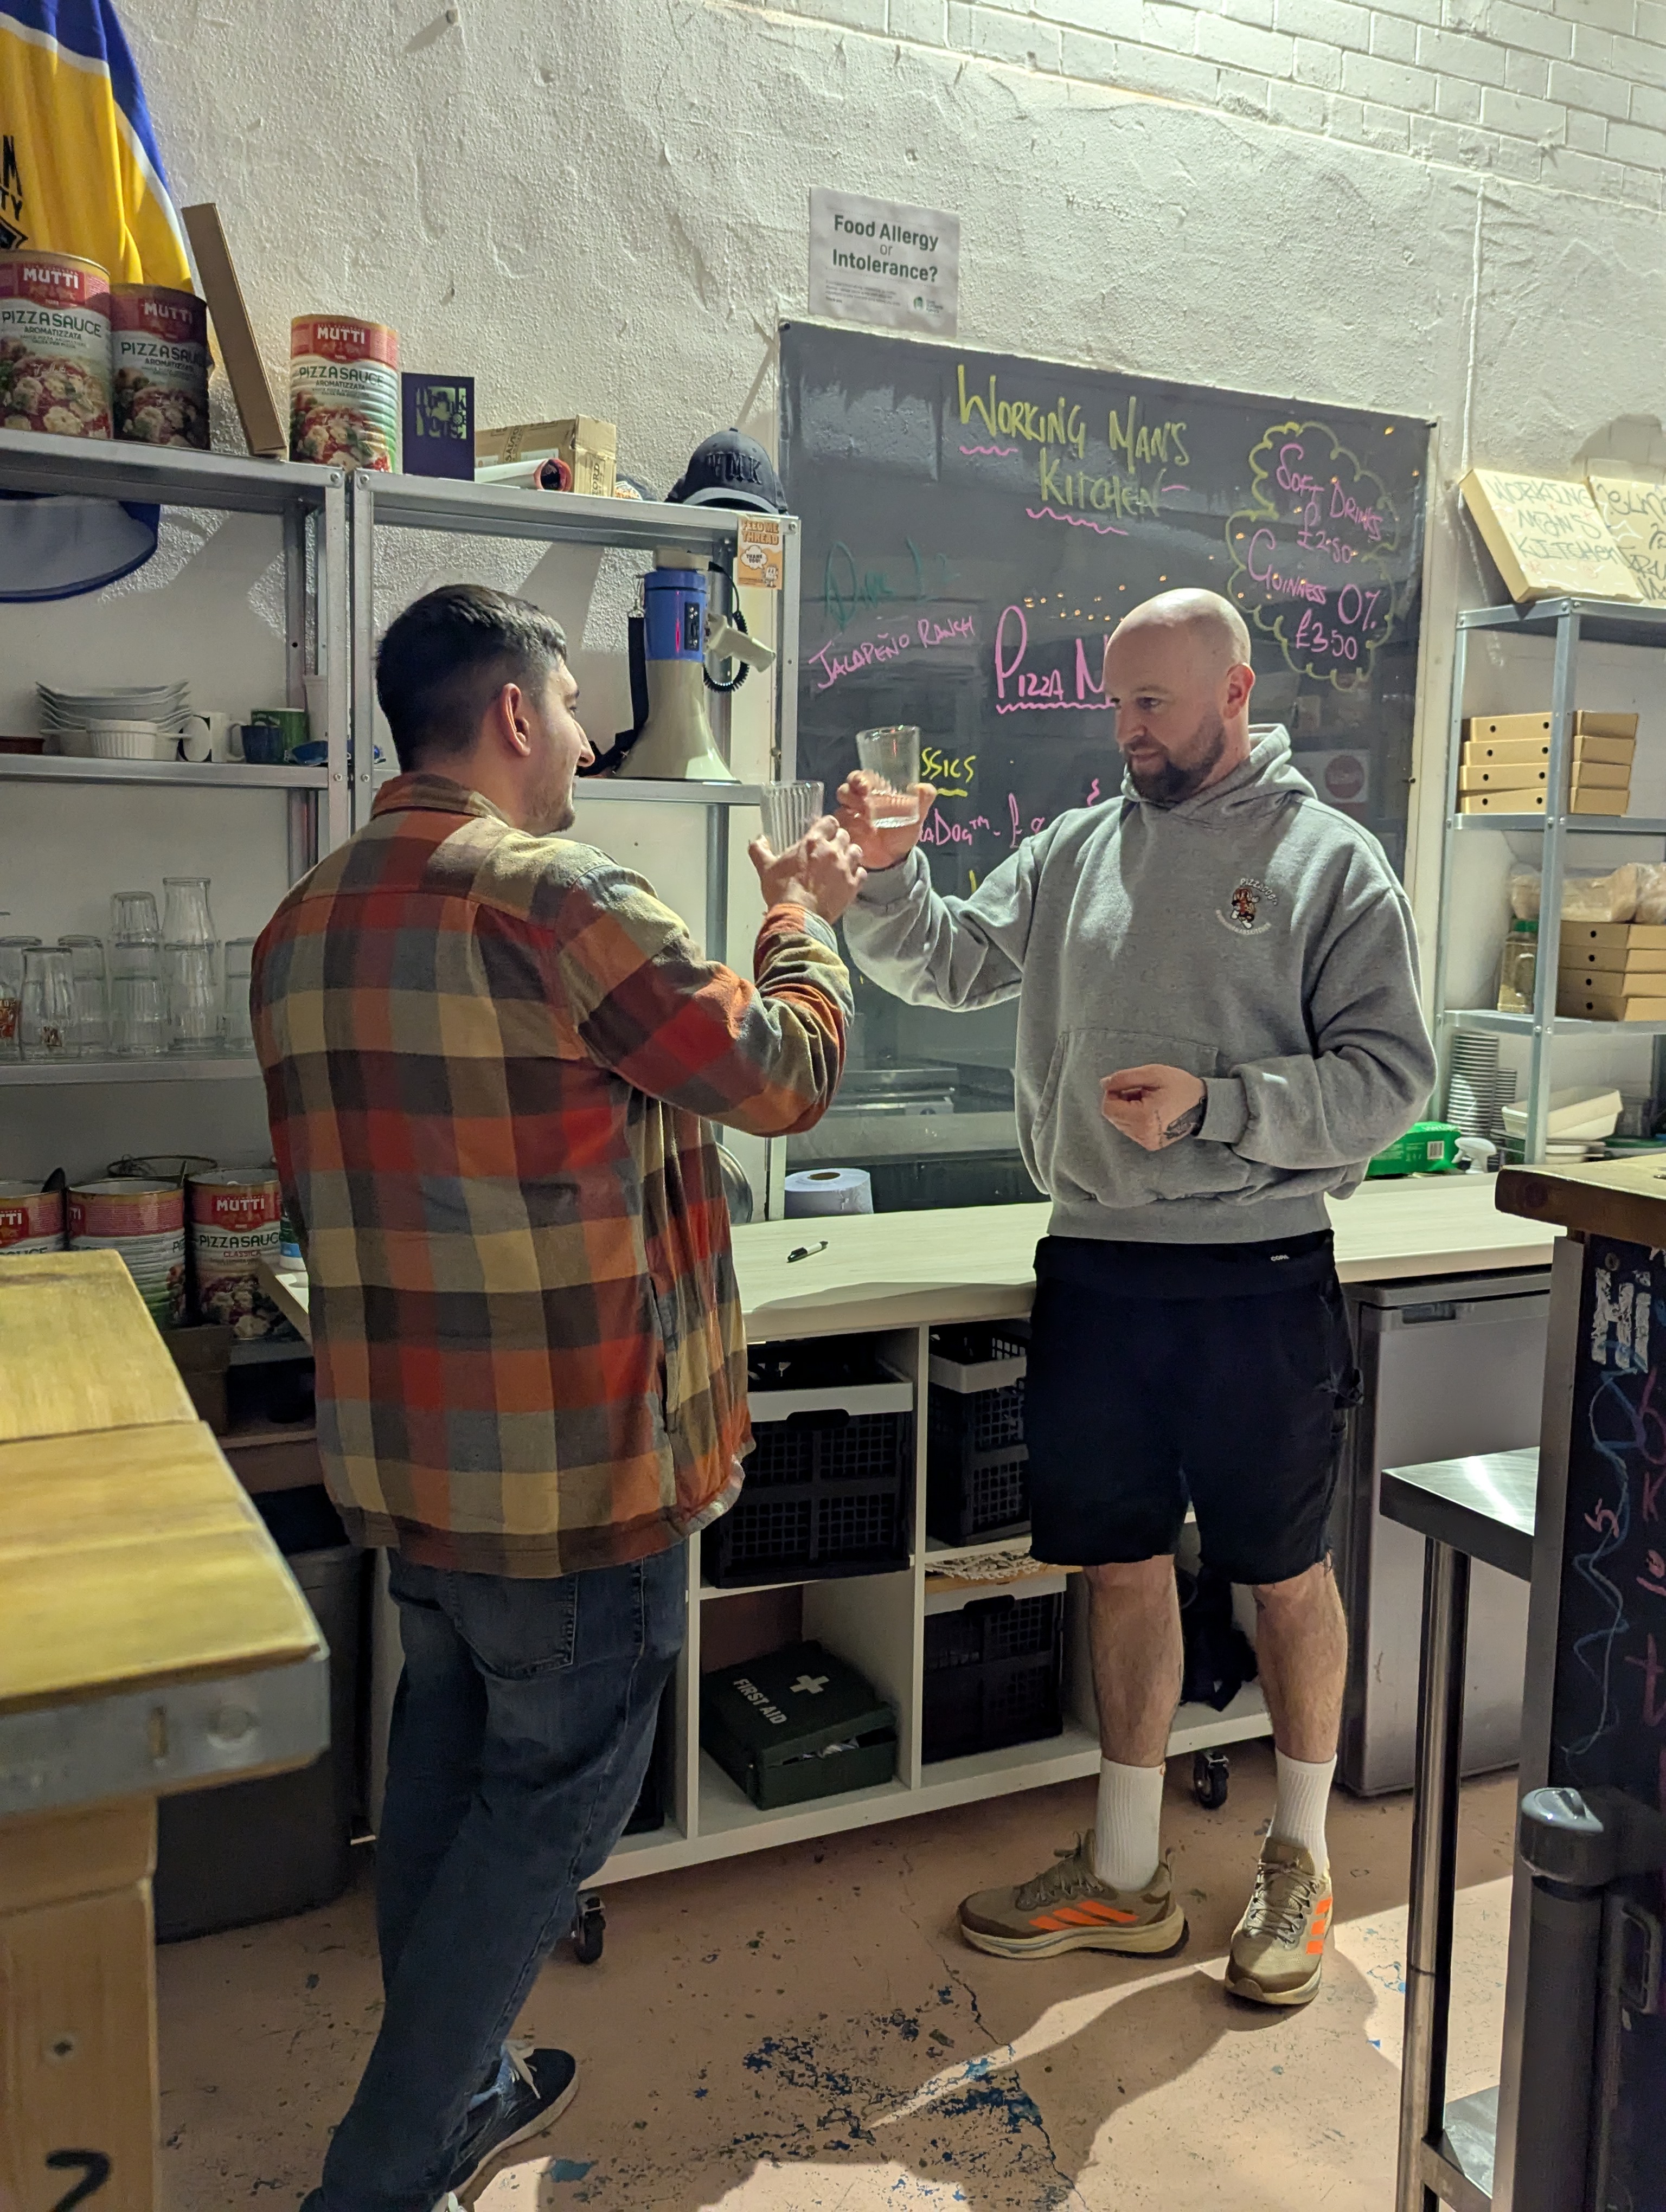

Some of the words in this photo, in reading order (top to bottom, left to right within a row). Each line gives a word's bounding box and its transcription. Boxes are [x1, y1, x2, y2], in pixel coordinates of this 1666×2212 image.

[834, 214, 876, 237] Food
[879, 223, 939, 252] Allergy
[879, 244, 893, 256] or
[832, 248, 938, 282] Intolerance?
[23, 268, 79, 290] MUTTI
[144, 302, 194, 325] MUTTI
[24, 326, 82, 341] AROMATIZZATA
[317, 326, 366, 345] MUTTI
[315, 380, 366, 390] AROMATIZZATA
[958, 364, 1085, 459] WORKING
[1039, 447, 1167, 518] KITCHEN
[742, 520, 764, 533] FEED
[765, 522, 779, 534] ME
[742, 531, 779, 545] THREAD
[995, 605, 1064, 701] PIZZA
[216, 1198, 265, 1212] MUTTI
[223, 1250, 262, 1258] CLASSICA
[1270, 1254, 1290, 1262] COPA
[733, 1678, 770, 1706] FIRST
[759, 1706, 787, 1724] AID
